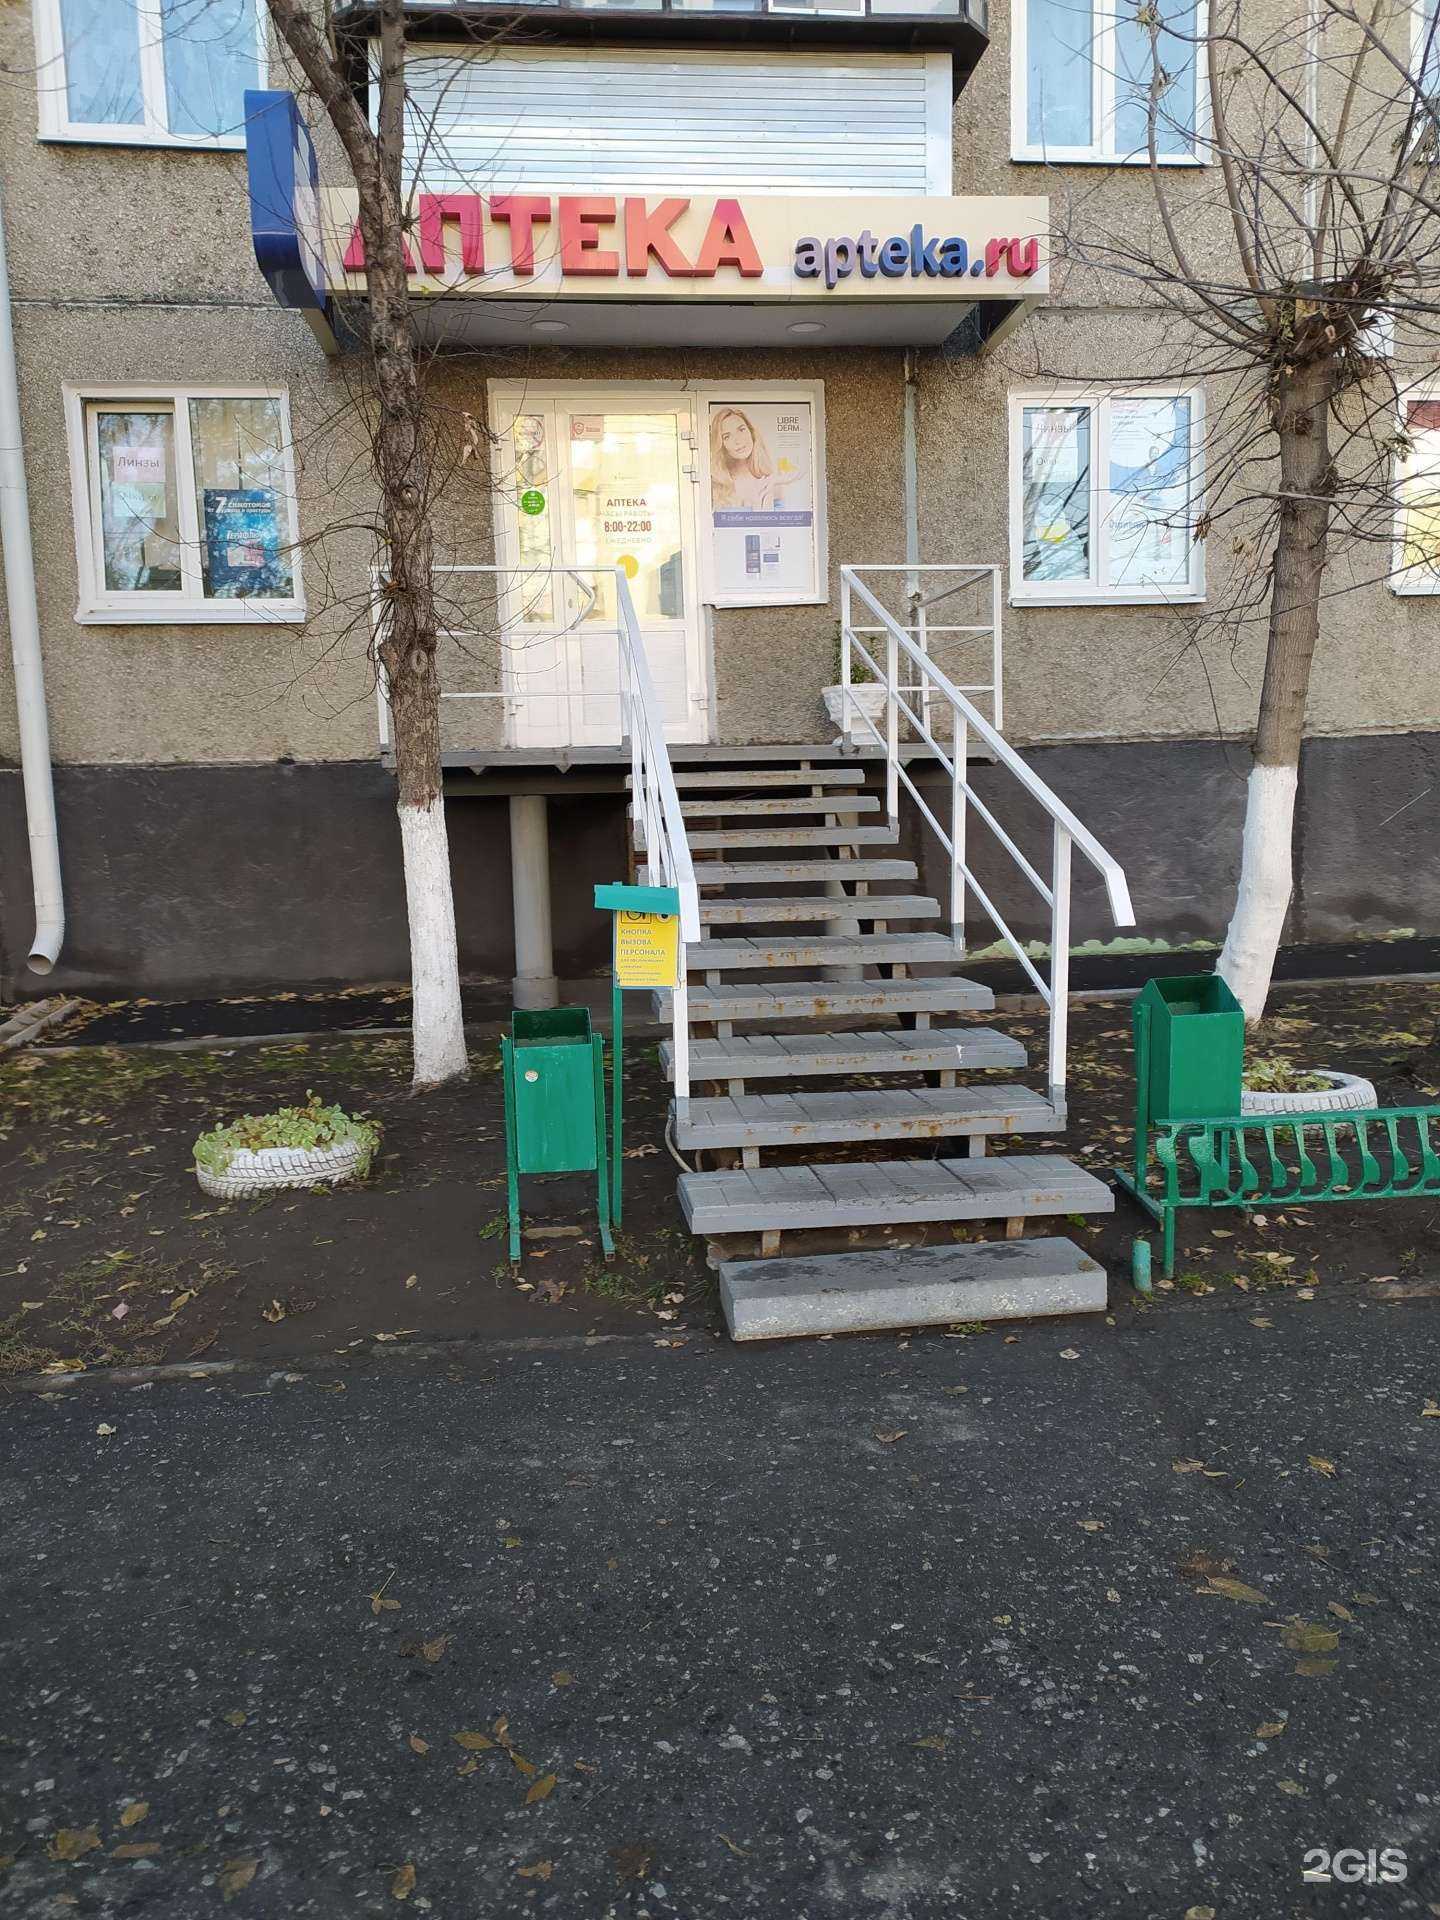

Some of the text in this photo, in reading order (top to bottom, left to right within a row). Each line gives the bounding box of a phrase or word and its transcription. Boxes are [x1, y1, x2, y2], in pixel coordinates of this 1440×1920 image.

[794, 223, 1039, 290] apteka.ru
[776, 416, 800, 424] LIBRE
[118, 456, 160, 468] Линзы
[215, 496, 228, 514] 7
[606, 498, 647, 507] АПТЕКА
[604, 520, 652, 532] 8:00-22:00
